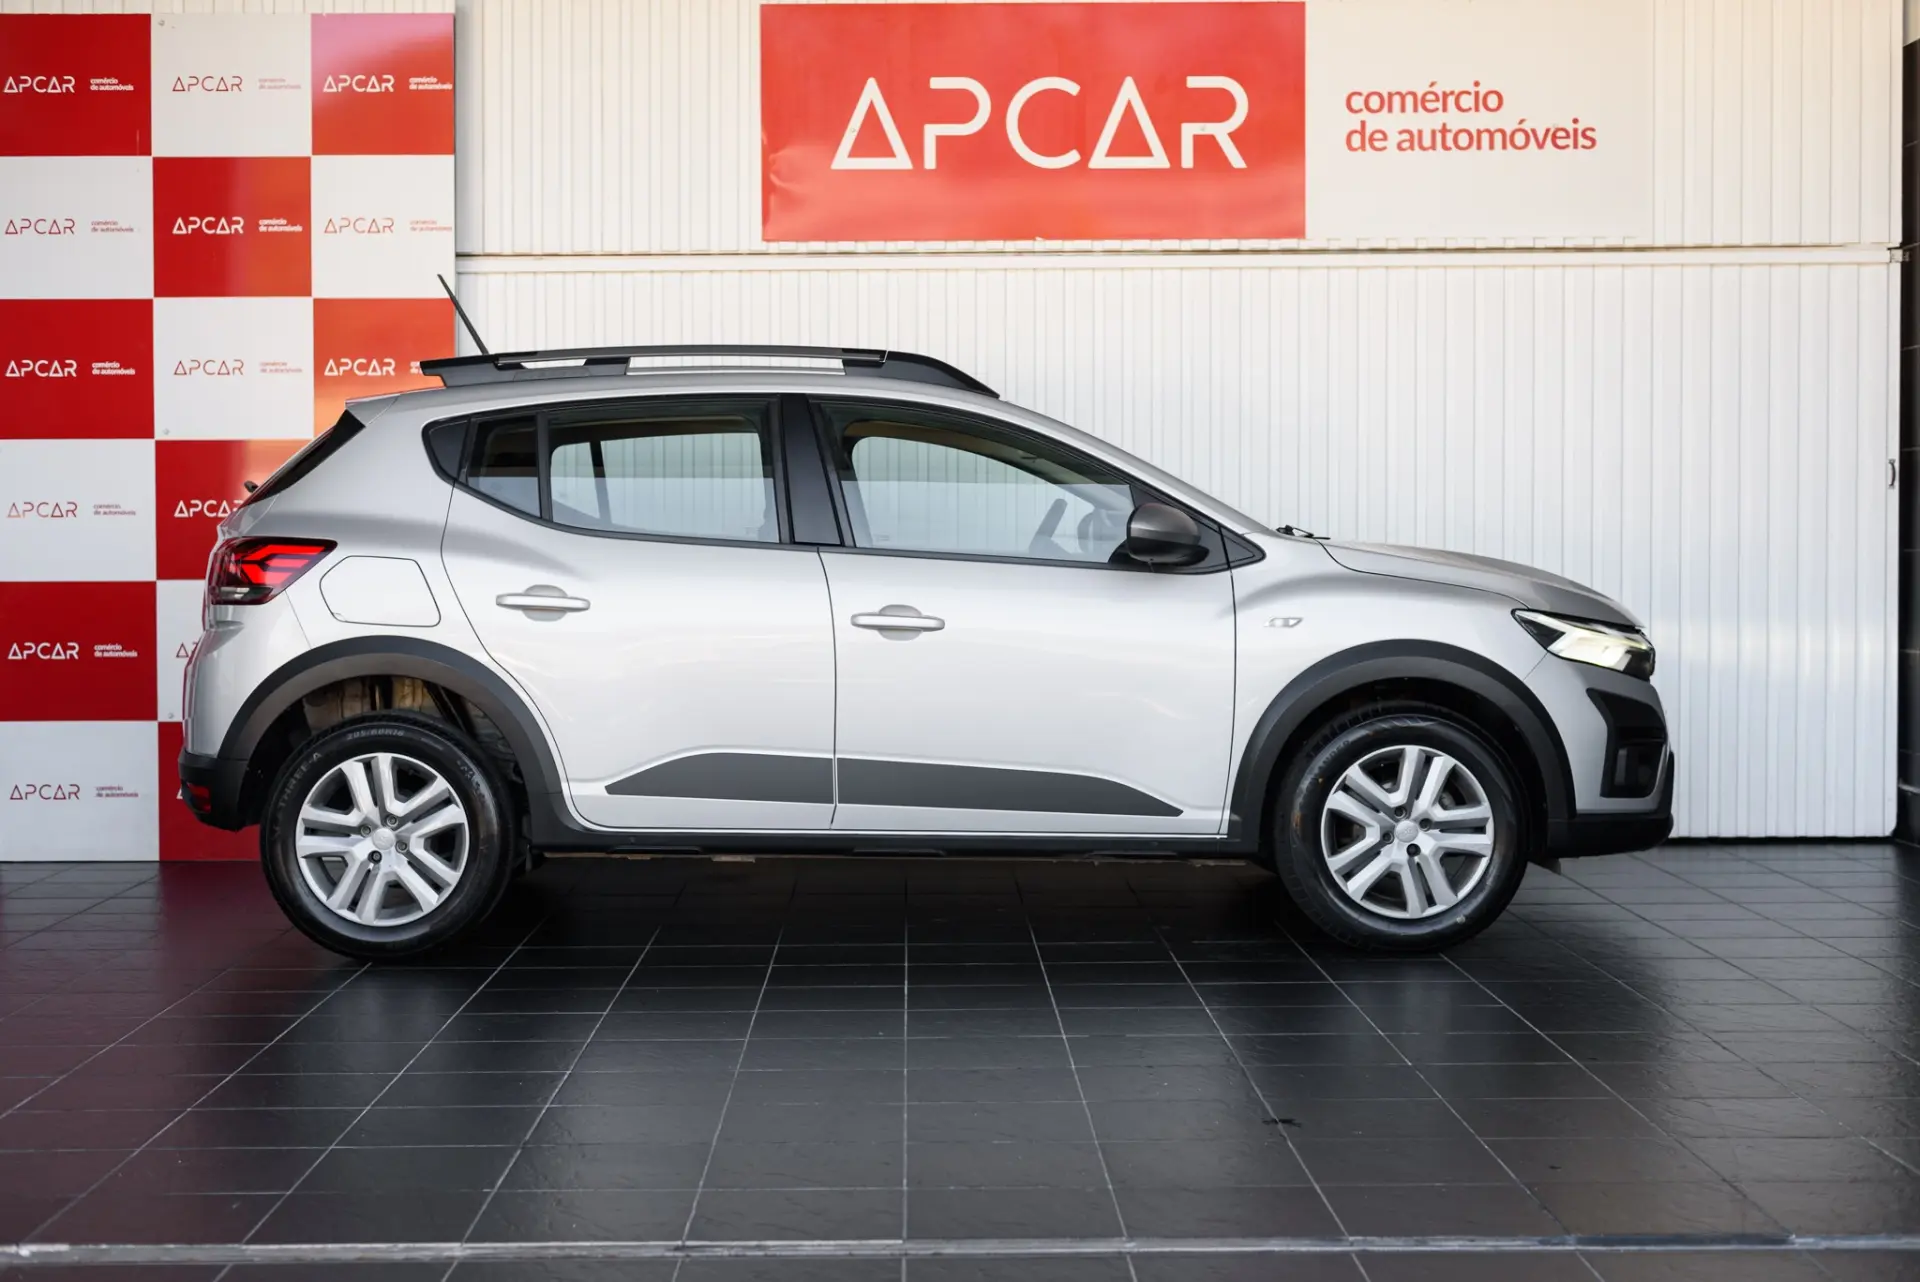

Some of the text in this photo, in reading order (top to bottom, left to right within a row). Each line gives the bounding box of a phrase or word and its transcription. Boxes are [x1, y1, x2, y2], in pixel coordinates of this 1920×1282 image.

[3, 75, 76, 93] APCAR
[172, 76, 243, 92] APCAR
[323, 75, 395, 92] APCAR
[1346, 80, 1504, 114] comércio
[830, 76, 1249, 171] APCAR
[1346, 117, 1597, 152] de automóveis
[5, 219, 76, 235] APCAR
[172, 217, 244, 235] APCAR
[324, 218, 395, 234] APCAR
[5, 360, 77, 377] APCAR
[174, 359, 244, 376] APCAR
[324, 358, 396, 376] APCAR
[8, 502, 78, 518] APCAR
[8, 642, 79, 660] APCAR
[10, 784, 80, 800] APCAR
